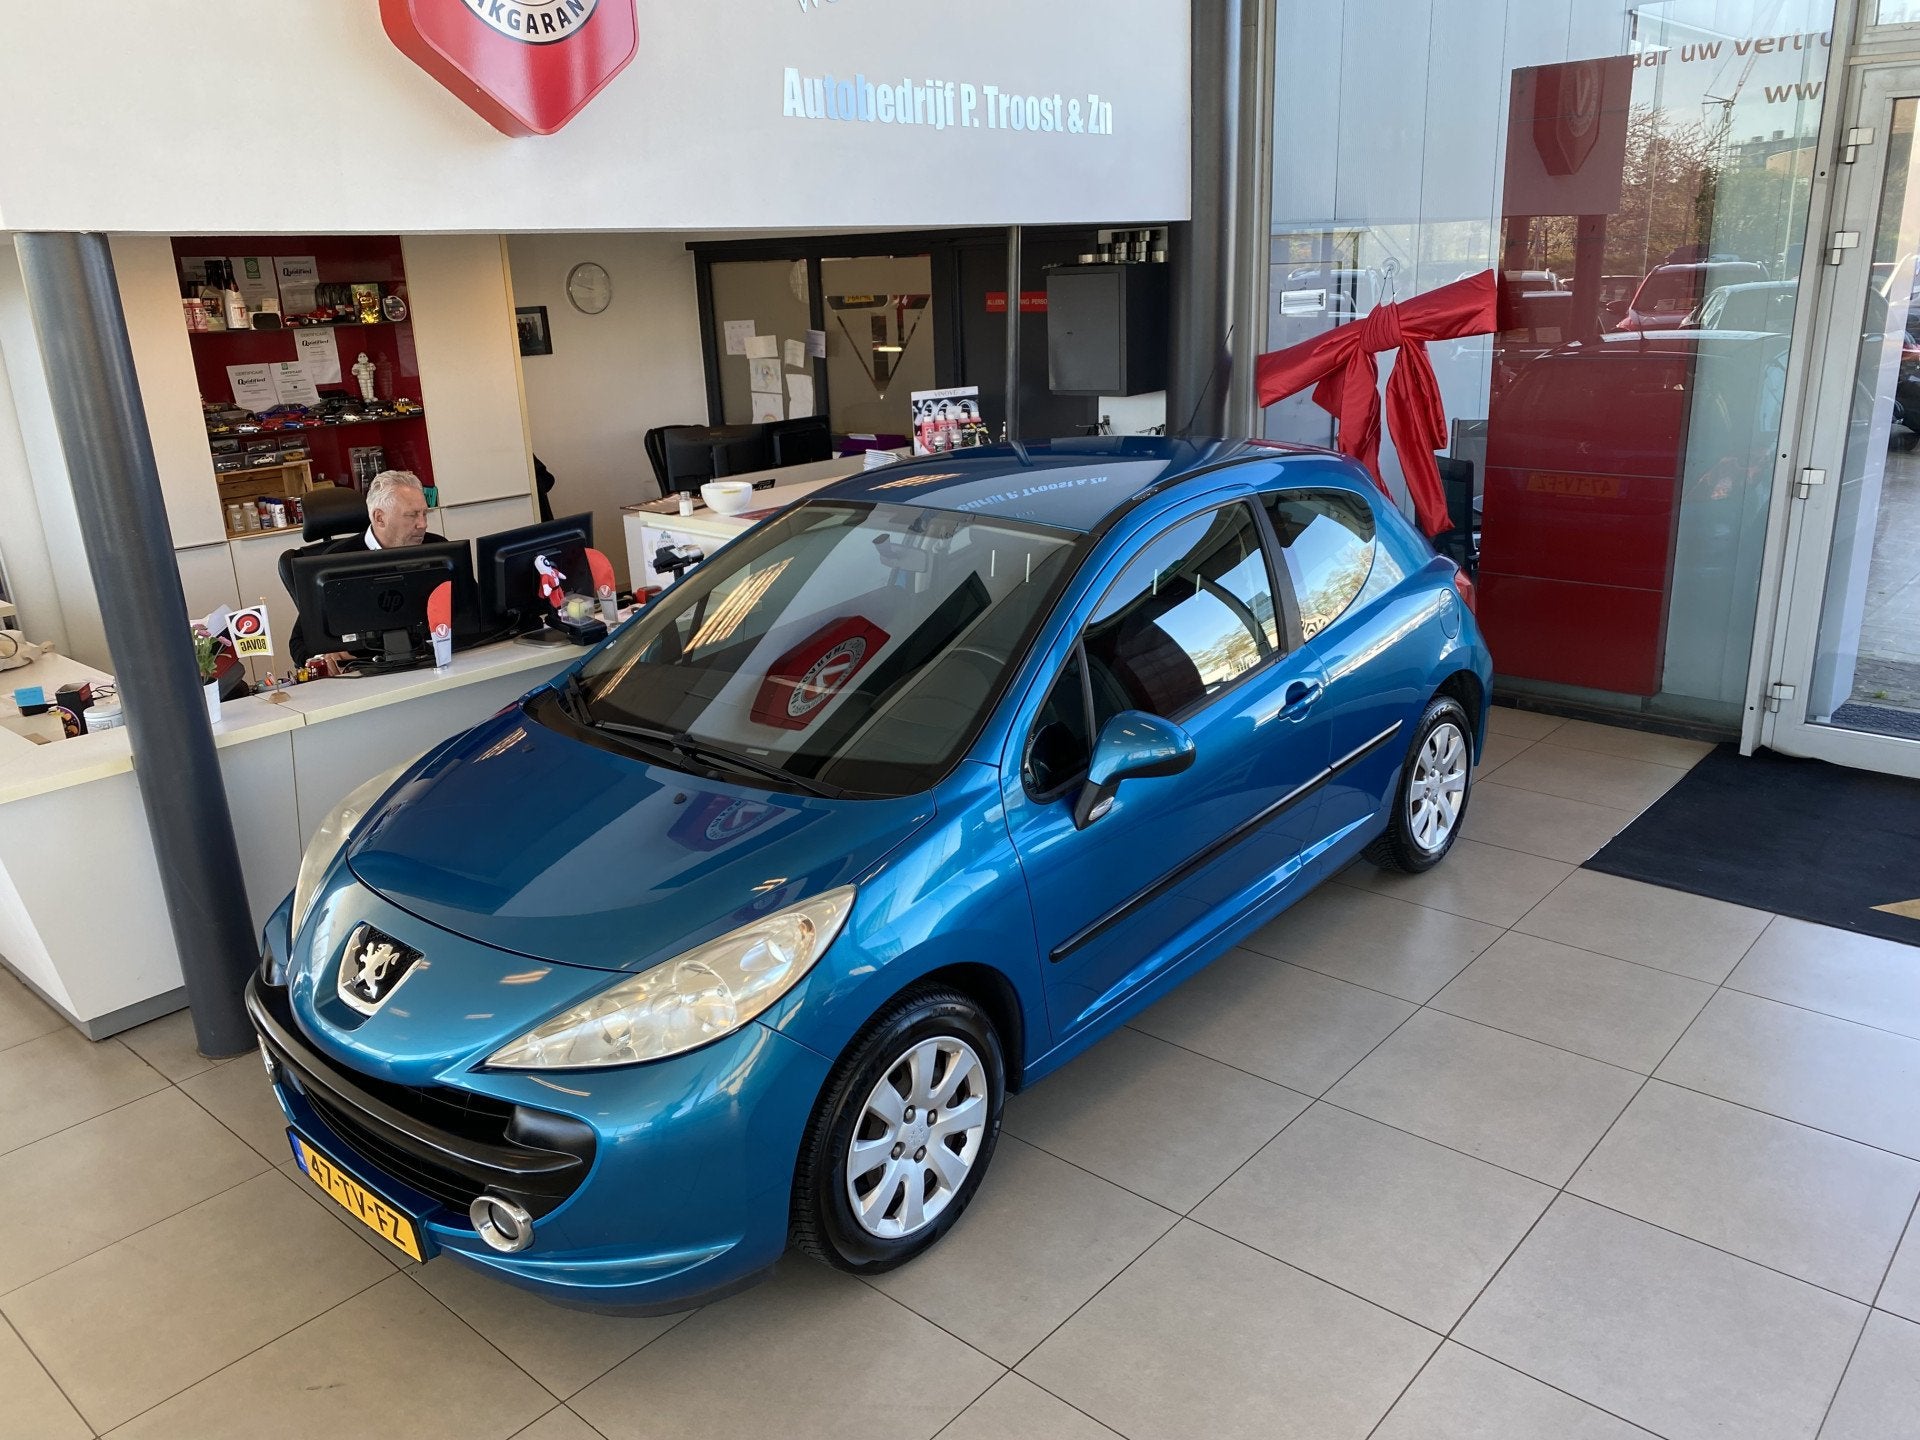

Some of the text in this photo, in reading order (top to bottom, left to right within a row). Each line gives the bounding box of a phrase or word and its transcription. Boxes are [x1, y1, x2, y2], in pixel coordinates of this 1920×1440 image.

[1681, 40, 1722, 62] uw
[783, 67, 1113, 135] Autobedrijf P. Troost & Zn
[311, 1154, 407, 1248] 47-TV-FZ
